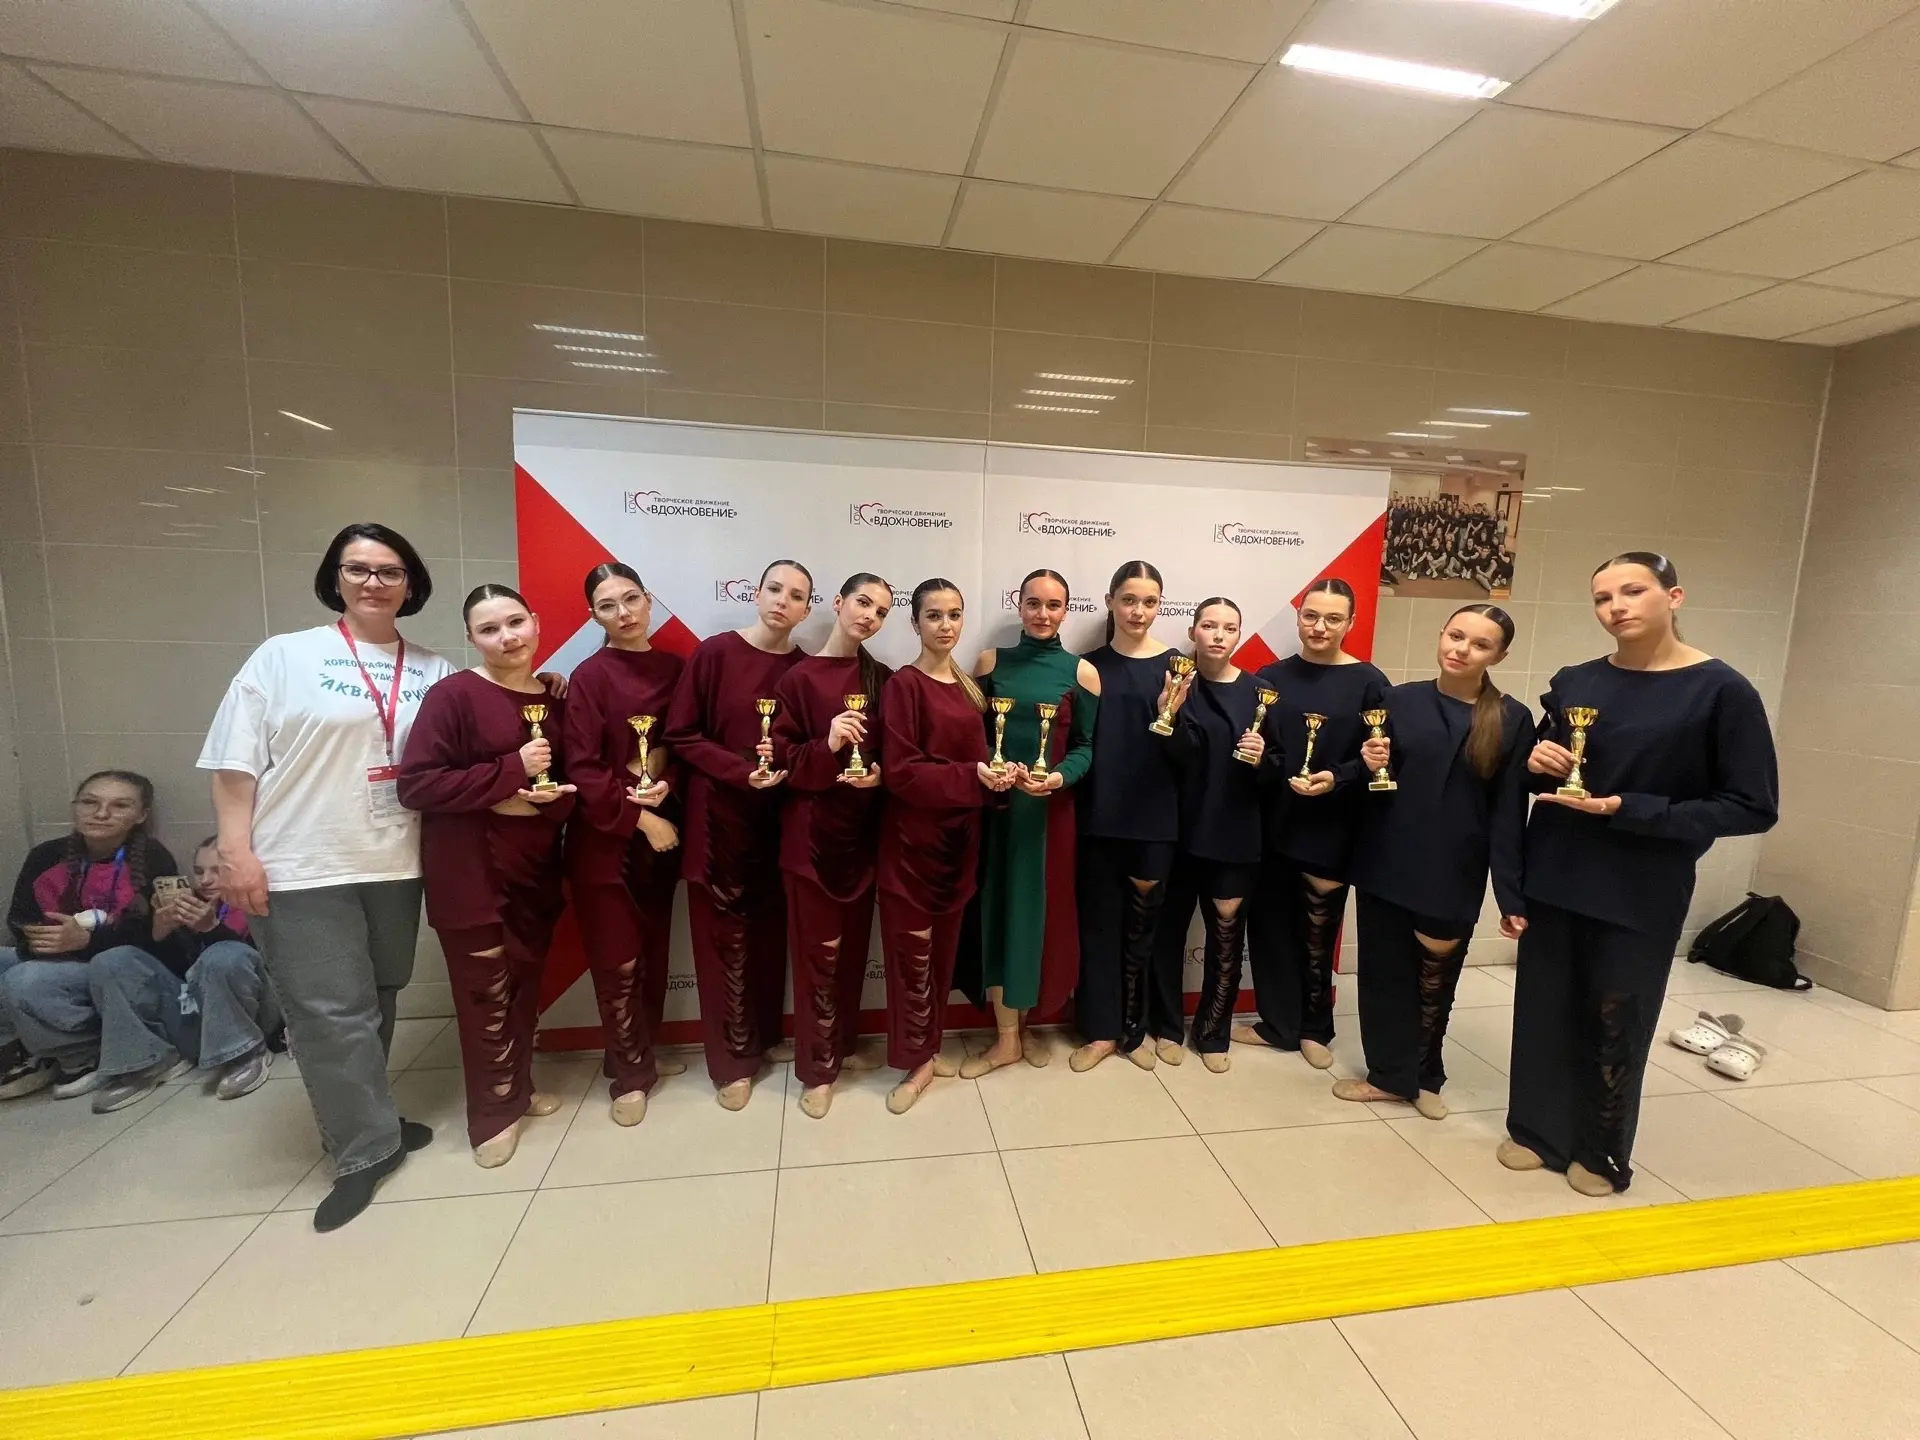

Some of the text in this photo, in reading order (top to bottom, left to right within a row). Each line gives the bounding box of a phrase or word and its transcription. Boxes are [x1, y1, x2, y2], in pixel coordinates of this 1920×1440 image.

[628, 491, 636, 513] LOVE
[654, 497, 693, 505] ТВОРЧЕСКОЕ
[646, 505, 738, 518] «ВДОХНОВЕНИЕ»
[870, 516, 953, 528] «ВДОХНОВЕНИЕ»
[1038, 525, 1116, 537] «ВДОХНОВЕНИЕ»
[1231, 535, 1304, 546] «ВДОХНОВЕНИЕ»
[323, 658, 424, 678] ХОРЕОРАФИЧСКАЯ
